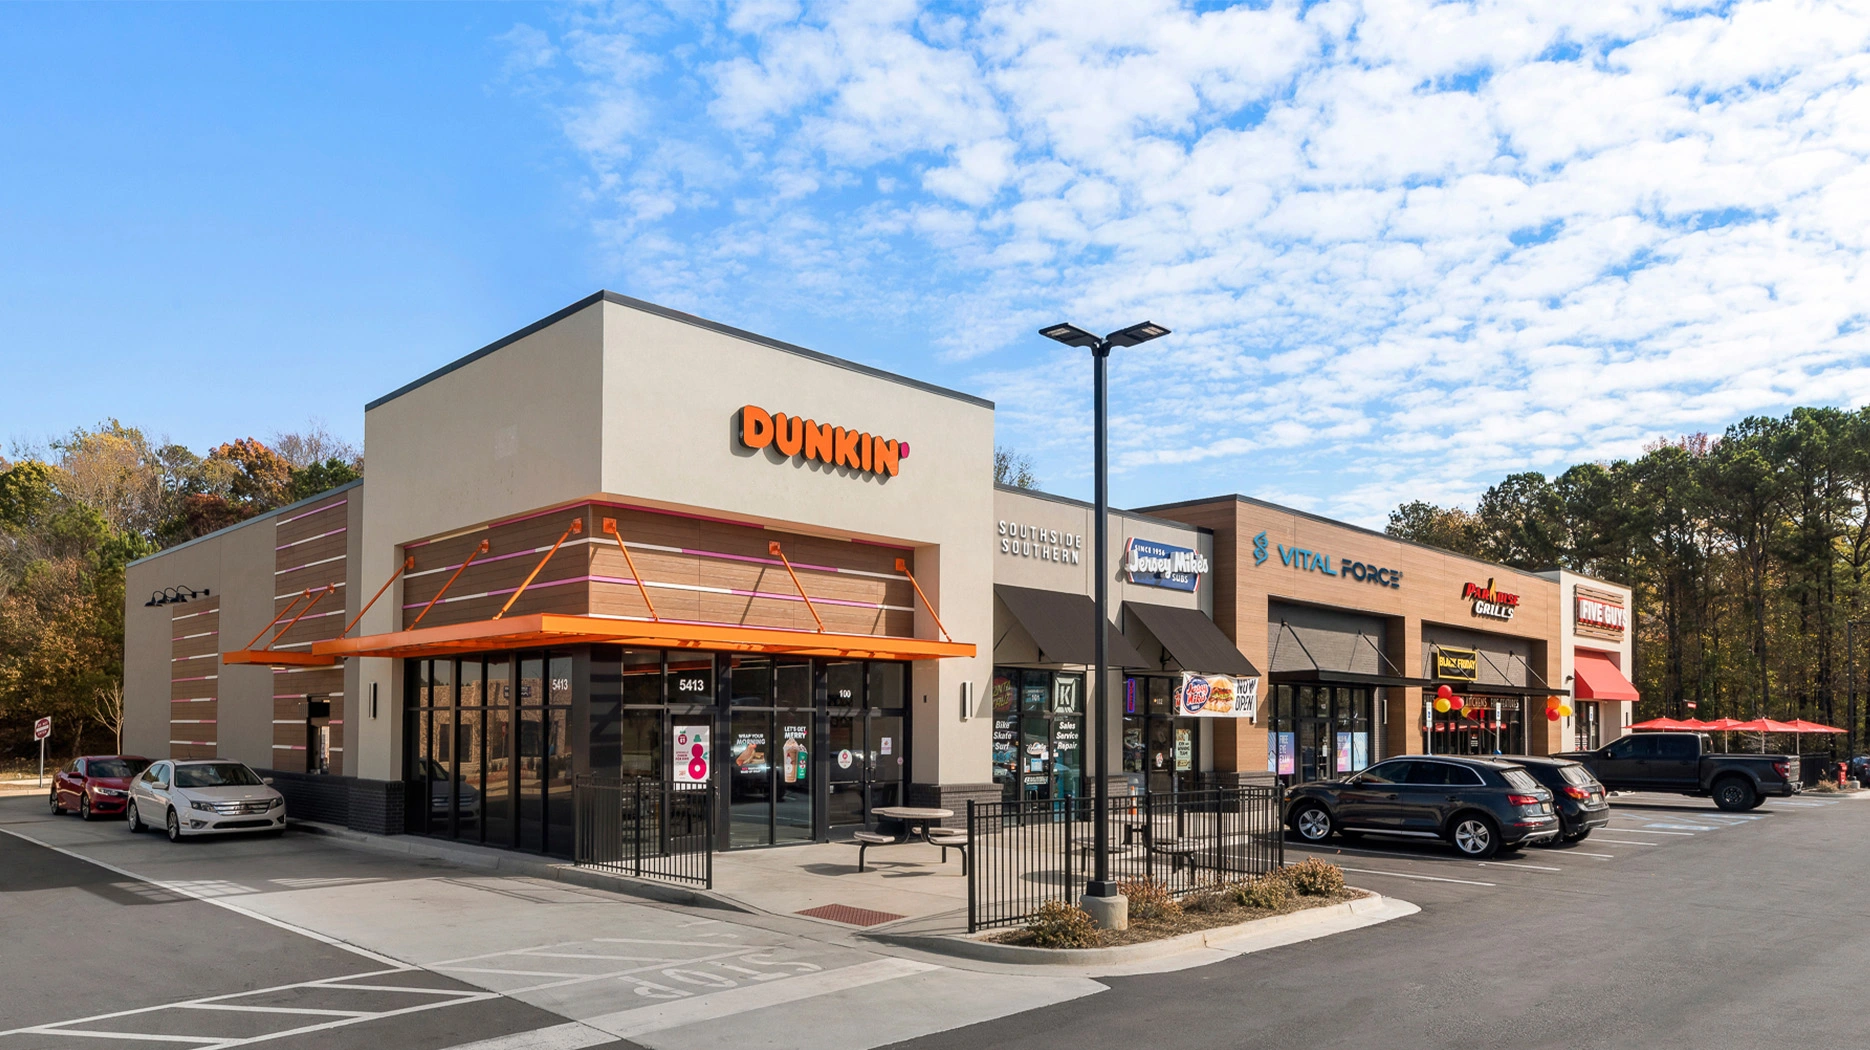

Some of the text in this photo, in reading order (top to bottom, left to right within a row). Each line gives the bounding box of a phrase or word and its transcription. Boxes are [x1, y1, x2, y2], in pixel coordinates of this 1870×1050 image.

[739, 404, 910, 477] DUNKIN'
[999, 520, 1081, 549] SOUTHSIDE
[1001, 538, 1079, 565] SOUTHERN
[1134, 544, 1166, 556] SINCE 1956
[1128, 549, 1172, 579] Jersey
[1278, 543, 1401, 588] VITAL FORCE
[1172, 573, 1189, 584] SUBS
[1475, 600, 1515, 619] GRILLS
[1579, 600, 1628, 628] FIVE GUYS
[1439, 656, 1476, 670] BLACK FRIDAY
[552, 679, 568, 690] 5413
[679, 679, 704, 691] 5413
[1237, 679, 1257, 694] NOW
[839, 689, 851, 698] 100
[1235, 695, 1254, 711] OPEN
[995, 720, 1010, 729] Bike
[1059, 721, 1075, 729] Sales
[993, 731, 1012, 740] Skate
[1056, 731, 1078, 739] Service
[995, 741, 1010, 750] Surf
[1057, 741, 1078, 751] Repair
[618, 953, 822, 999] STOP
